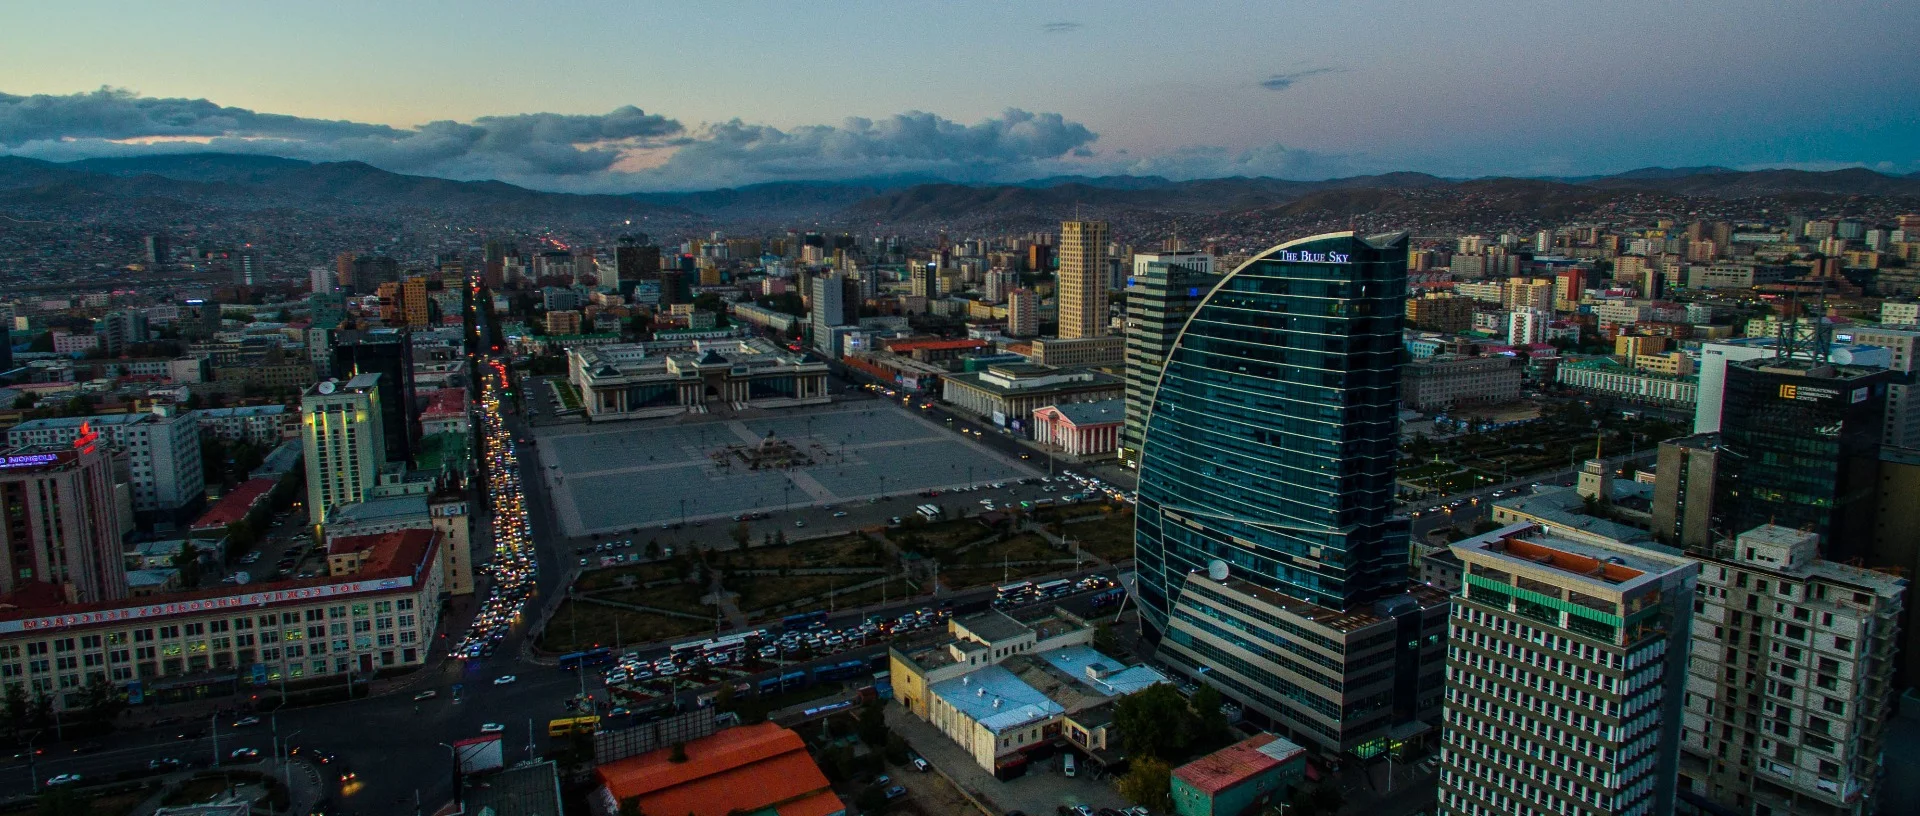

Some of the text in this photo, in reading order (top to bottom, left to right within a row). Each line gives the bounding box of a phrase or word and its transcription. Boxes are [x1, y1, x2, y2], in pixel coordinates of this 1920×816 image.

[1796, 386, 1840, 395] INTERNATIONAL
[1796, 391, 1833, 399] COMMERCIAL
[8, 453, 58, 463] MONGOLIA
